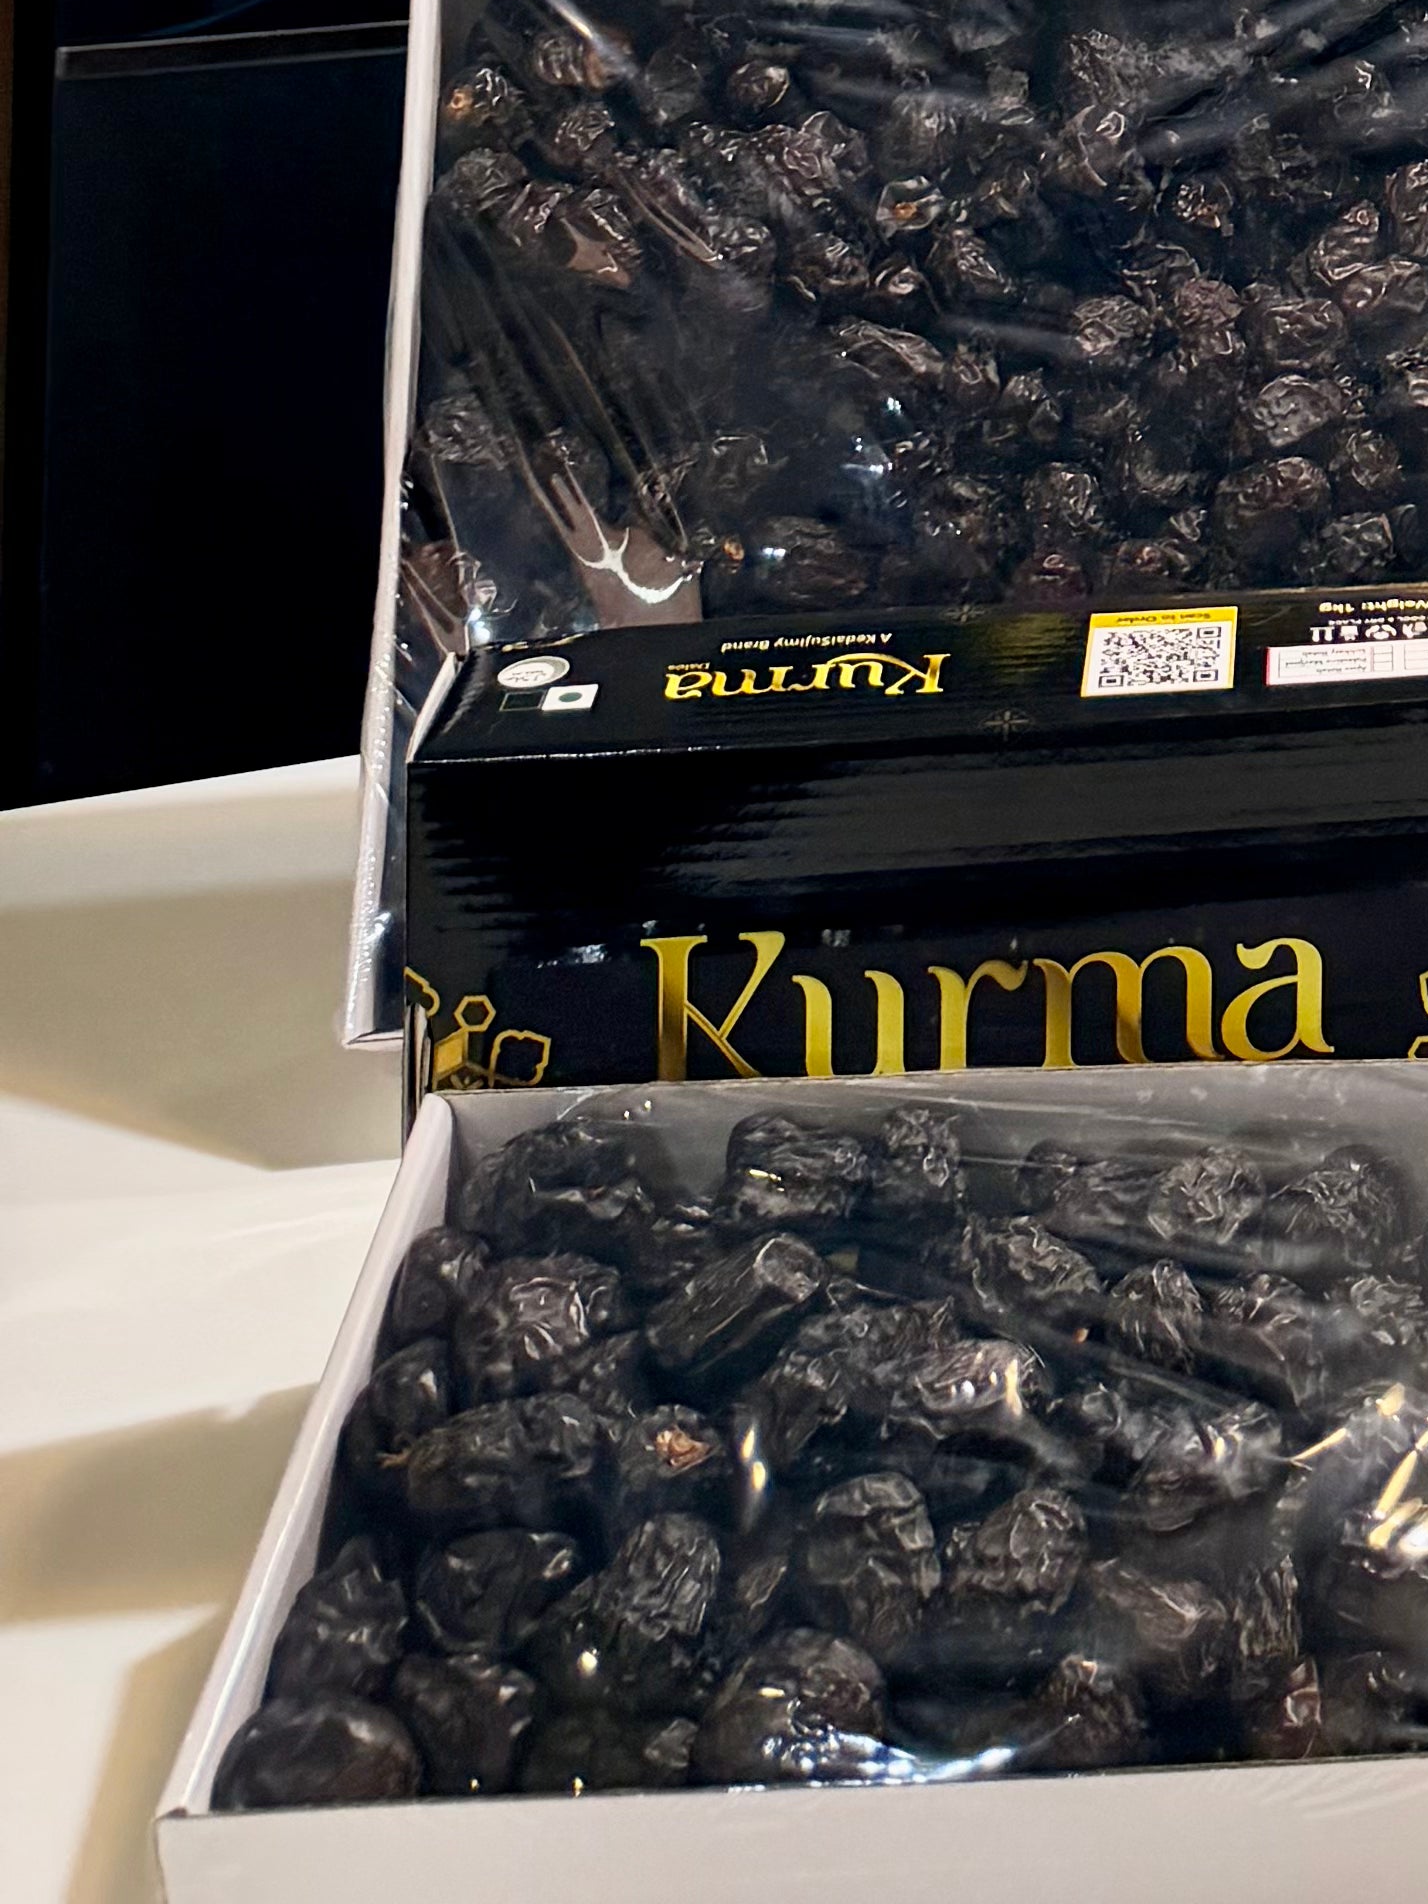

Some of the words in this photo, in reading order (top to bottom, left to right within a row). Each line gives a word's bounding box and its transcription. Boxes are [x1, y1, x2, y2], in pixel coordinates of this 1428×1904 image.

[1318, 601, 1355, 614] 1kg
[721, 640, 771, 654] Brand
[664, 652, 952, 701] Kurma
[640, 931, 1335, 1081] Kurma
